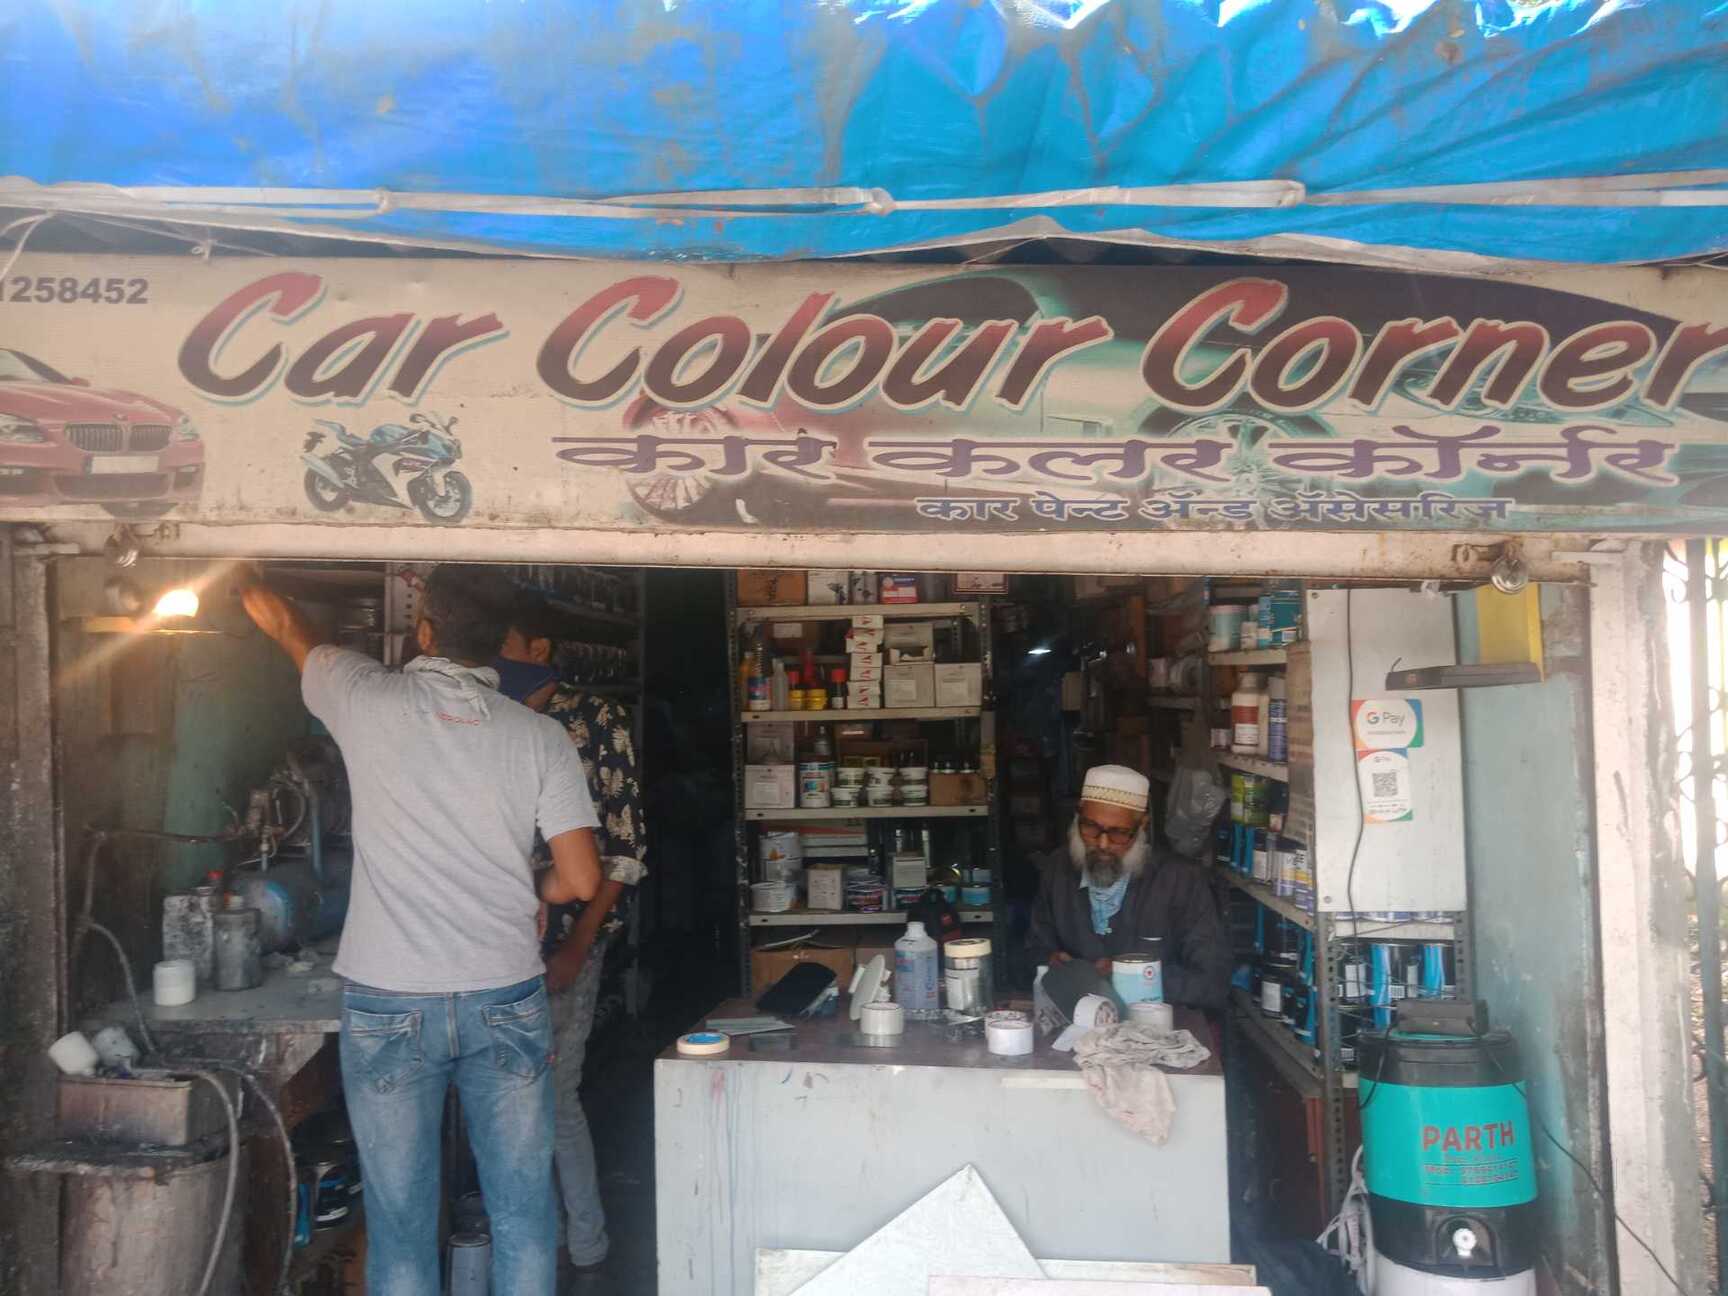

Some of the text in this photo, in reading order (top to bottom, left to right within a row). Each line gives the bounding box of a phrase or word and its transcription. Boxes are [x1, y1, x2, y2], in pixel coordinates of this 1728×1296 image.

[179, 271, 1728, 412] Car Colour Corner
[551, 425, 1677, 483] कार कलर कॉर्नर
[915, 497, 1019, 520] कार
[1030, 491, 1129, 521] पेन्ट
[1382, 711, 1405, 726] Pay
[1423, 1119, 1515, 1152] PARTH
